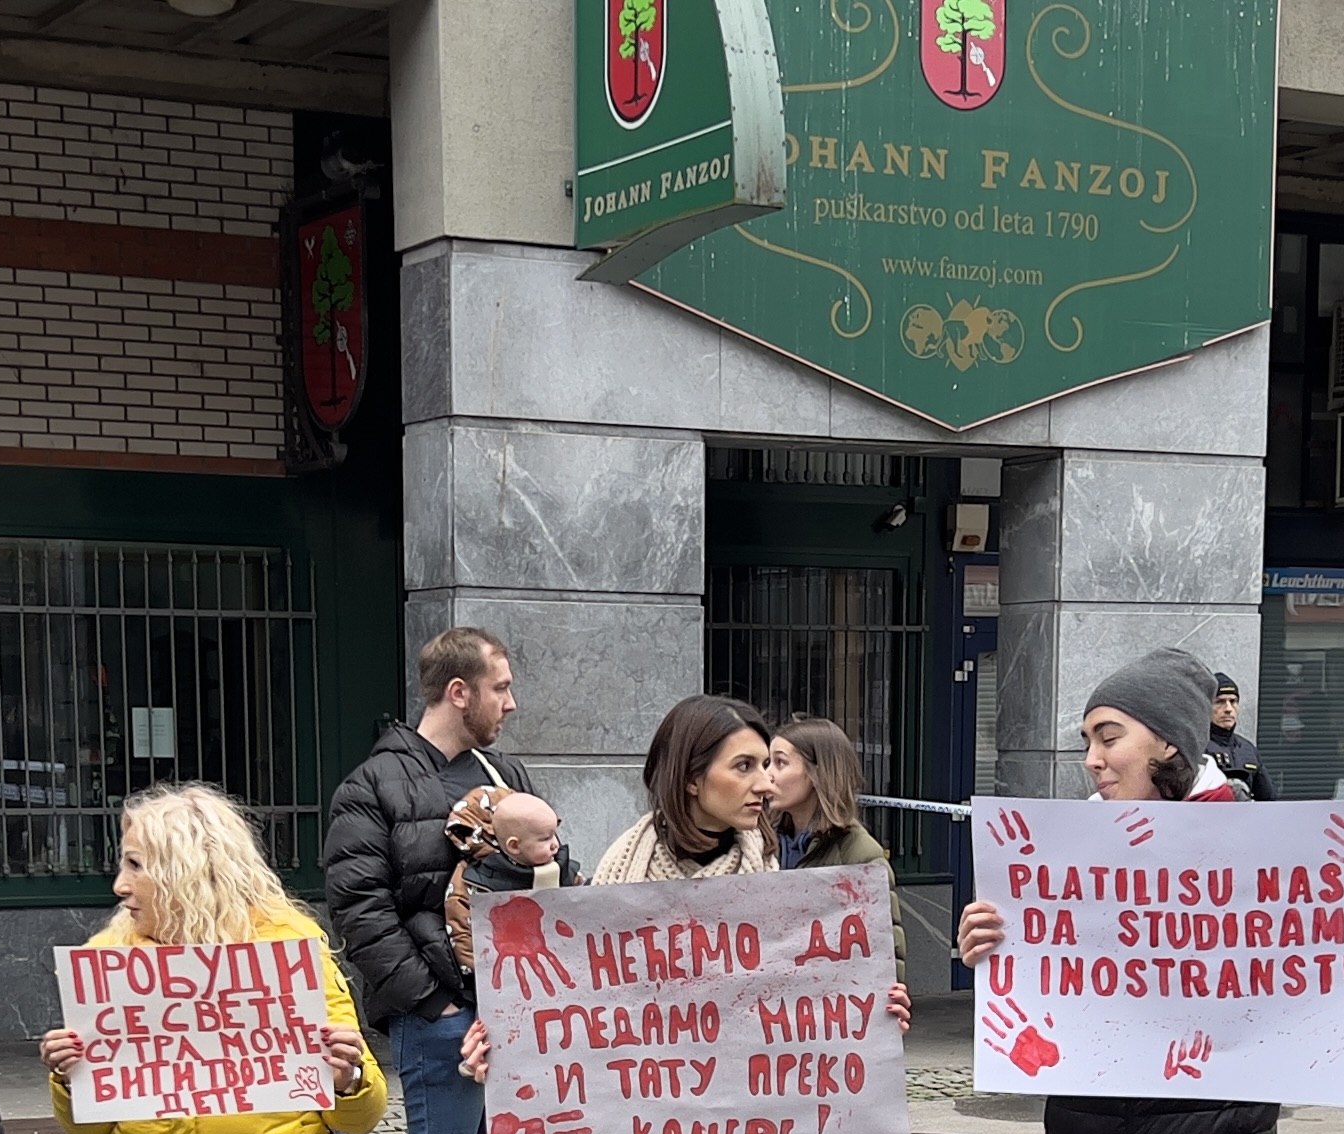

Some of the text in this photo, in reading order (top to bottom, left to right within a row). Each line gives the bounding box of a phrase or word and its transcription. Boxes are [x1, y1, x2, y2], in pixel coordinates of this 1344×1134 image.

[583, 153, 731, 223] JOHANN FANZOJ
[980, 149, 1170, 204] FANZOJ
[813, 192, 1099, 241] puškarstvo od leta 1790
[881, 256, 1044, 288] www.fanzoj.com
[1256, 862, 1344, 904] NAS
[1023, 907, 1077, 945] DA
[70, 938, 319, 1004] ПРОБУДИ
[585, 913, 871, 991] НЕЋЕМО ДА
[988, 954, 1014, 996] U
[95, 993, 304, 1036] СЕ СВЕТЕ
[533, 992, 875, 1055] ГЛЕДАМО МАМУ
[85, 1035, 204, 1064] СУТРА
[92, 1054, 289, 1103] БИТИ ТВОЈЕ
[155, 1086, 254, 1118] ДЕТЕ
[554, 1052, 865, 1104] И ТАТУ ПРЕКО
